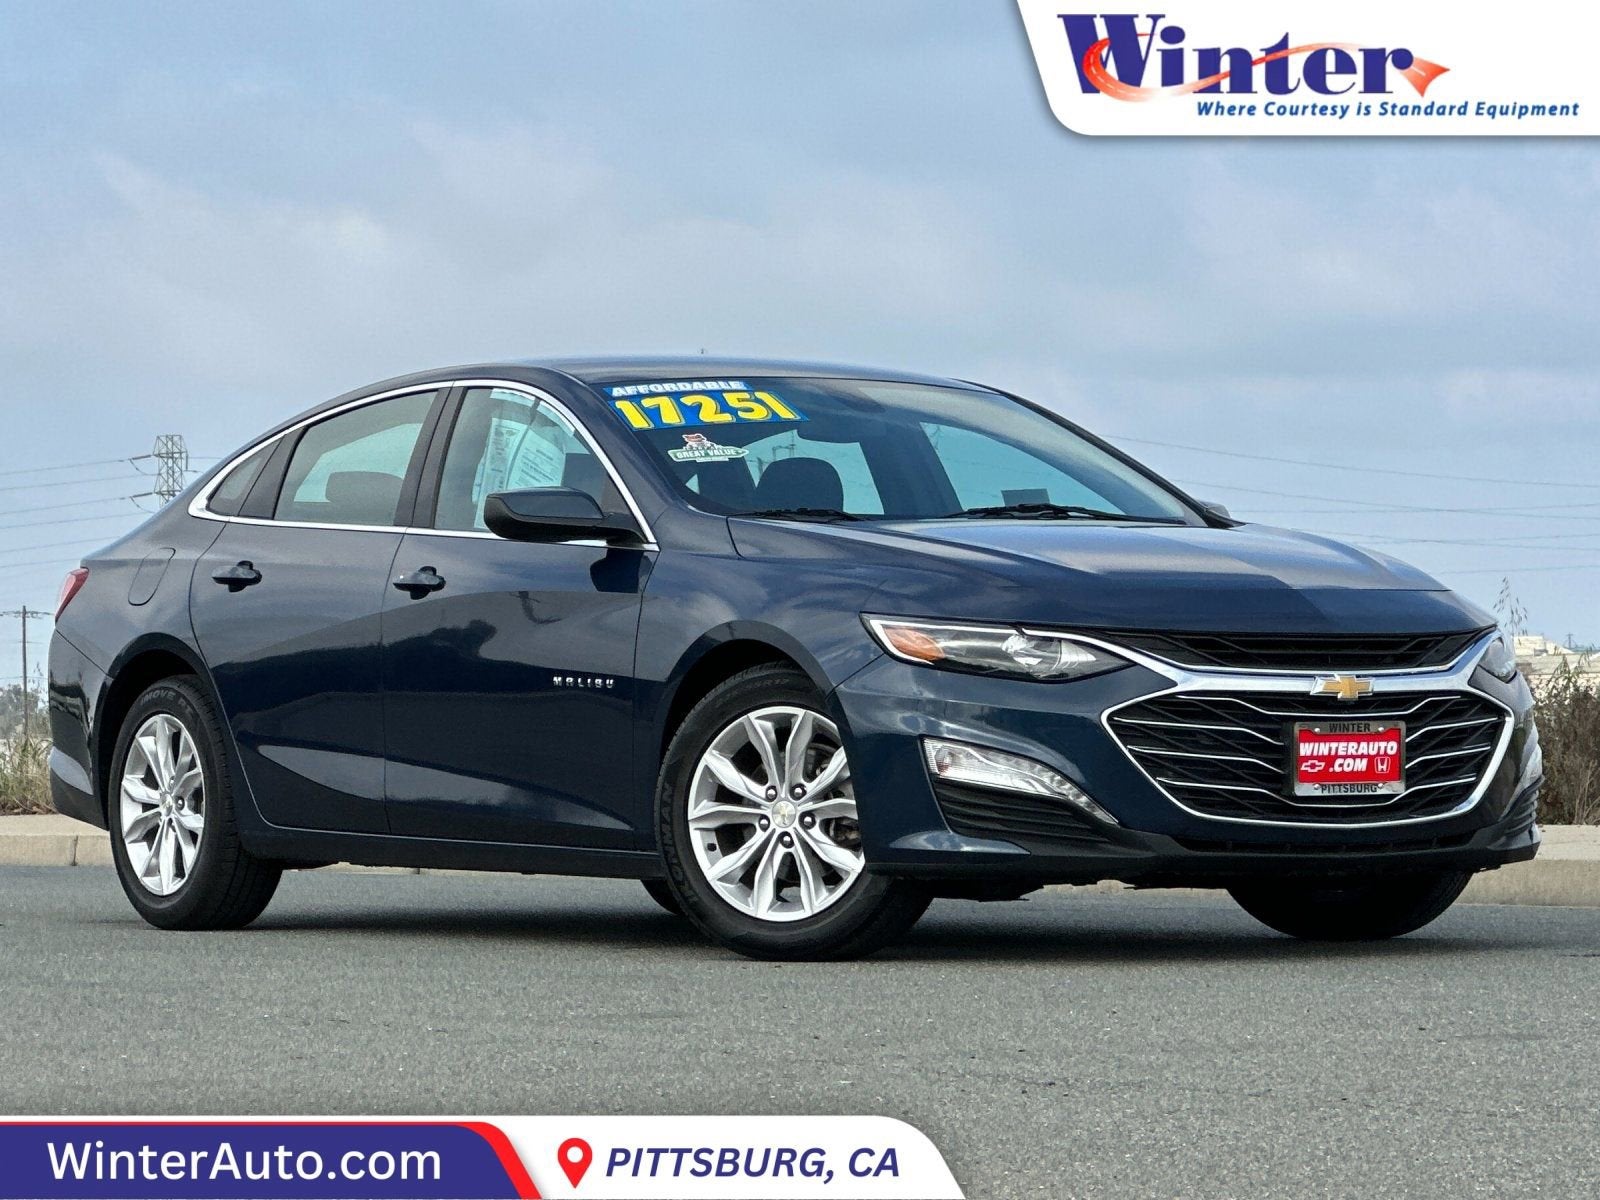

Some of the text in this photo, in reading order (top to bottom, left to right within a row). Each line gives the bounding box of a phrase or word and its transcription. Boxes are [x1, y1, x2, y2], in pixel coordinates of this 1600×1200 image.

[612, 380, 747, 397] AFFORDABLE
[615, 391, 799, 429] 17251
[676, 448, 737, 459] GREAT VALUE
[553, 676, 614, 688] MALIBU
[1328, 722, 1371, 733] WINTER
[1300, 741, 1398, 756] WINTERAUTO
[1321, 783, 1377, 793] PITTSBURG
